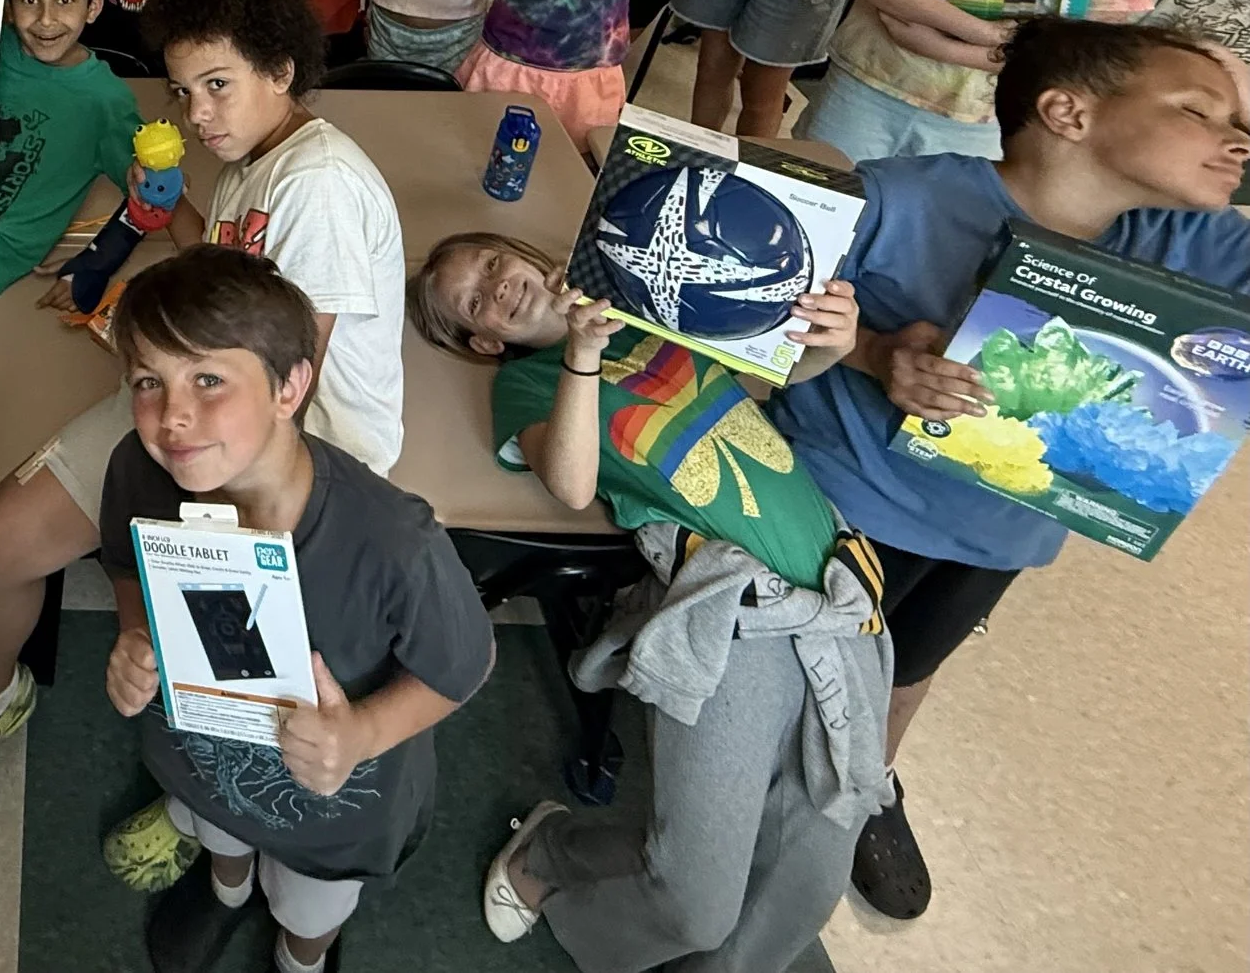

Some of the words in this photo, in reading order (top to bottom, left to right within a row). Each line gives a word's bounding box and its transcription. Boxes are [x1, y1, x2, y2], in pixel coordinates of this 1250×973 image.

[624, 148, 667, 166] ATHLETIC
[789, 193, 818, 207] Soccer
[819, 202, 837, 213] Ball
[1022, 254, 1075, 279] Science
[1076, 273, 1098, 286] Of
[1015, 265, 1078, 295] Crystal
[1080, 289, 1157, 325] Growing
[771, 344, 797, 369] 5
[1192, 344, 1250, 374] EARTH
[908, 444, 934, 461] STEM
[143, 540, 187, 557] DOODLE
[187, 545, 229, 562] TABLET
[260, 556, 284, 568] GEAR
